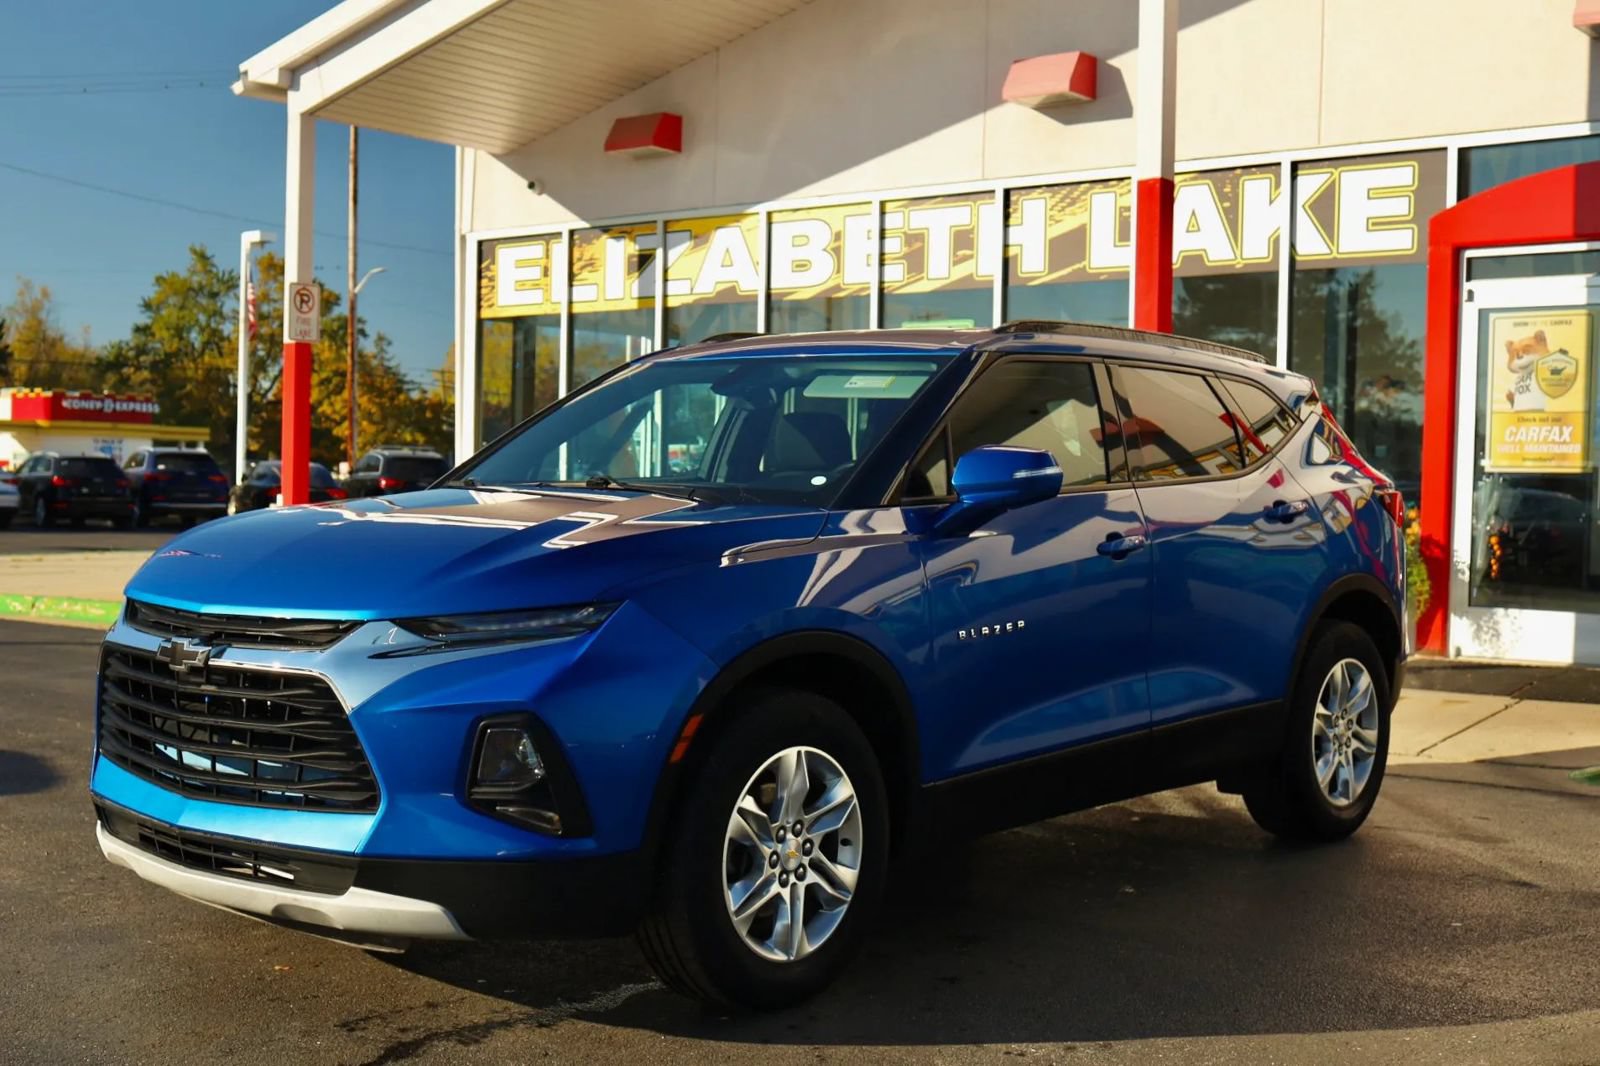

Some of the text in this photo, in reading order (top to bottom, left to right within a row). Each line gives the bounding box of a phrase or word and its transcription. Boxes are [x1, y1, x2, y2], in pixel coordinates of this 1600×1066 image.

[497, 162, 1418, 308] ELIZABETH LAKE
[62, 398, 160, 414] CONEY EXPRESS
[1504, 425, 1573, 442] CARFAX
[958, 620, 1025, 639] BLAZER
